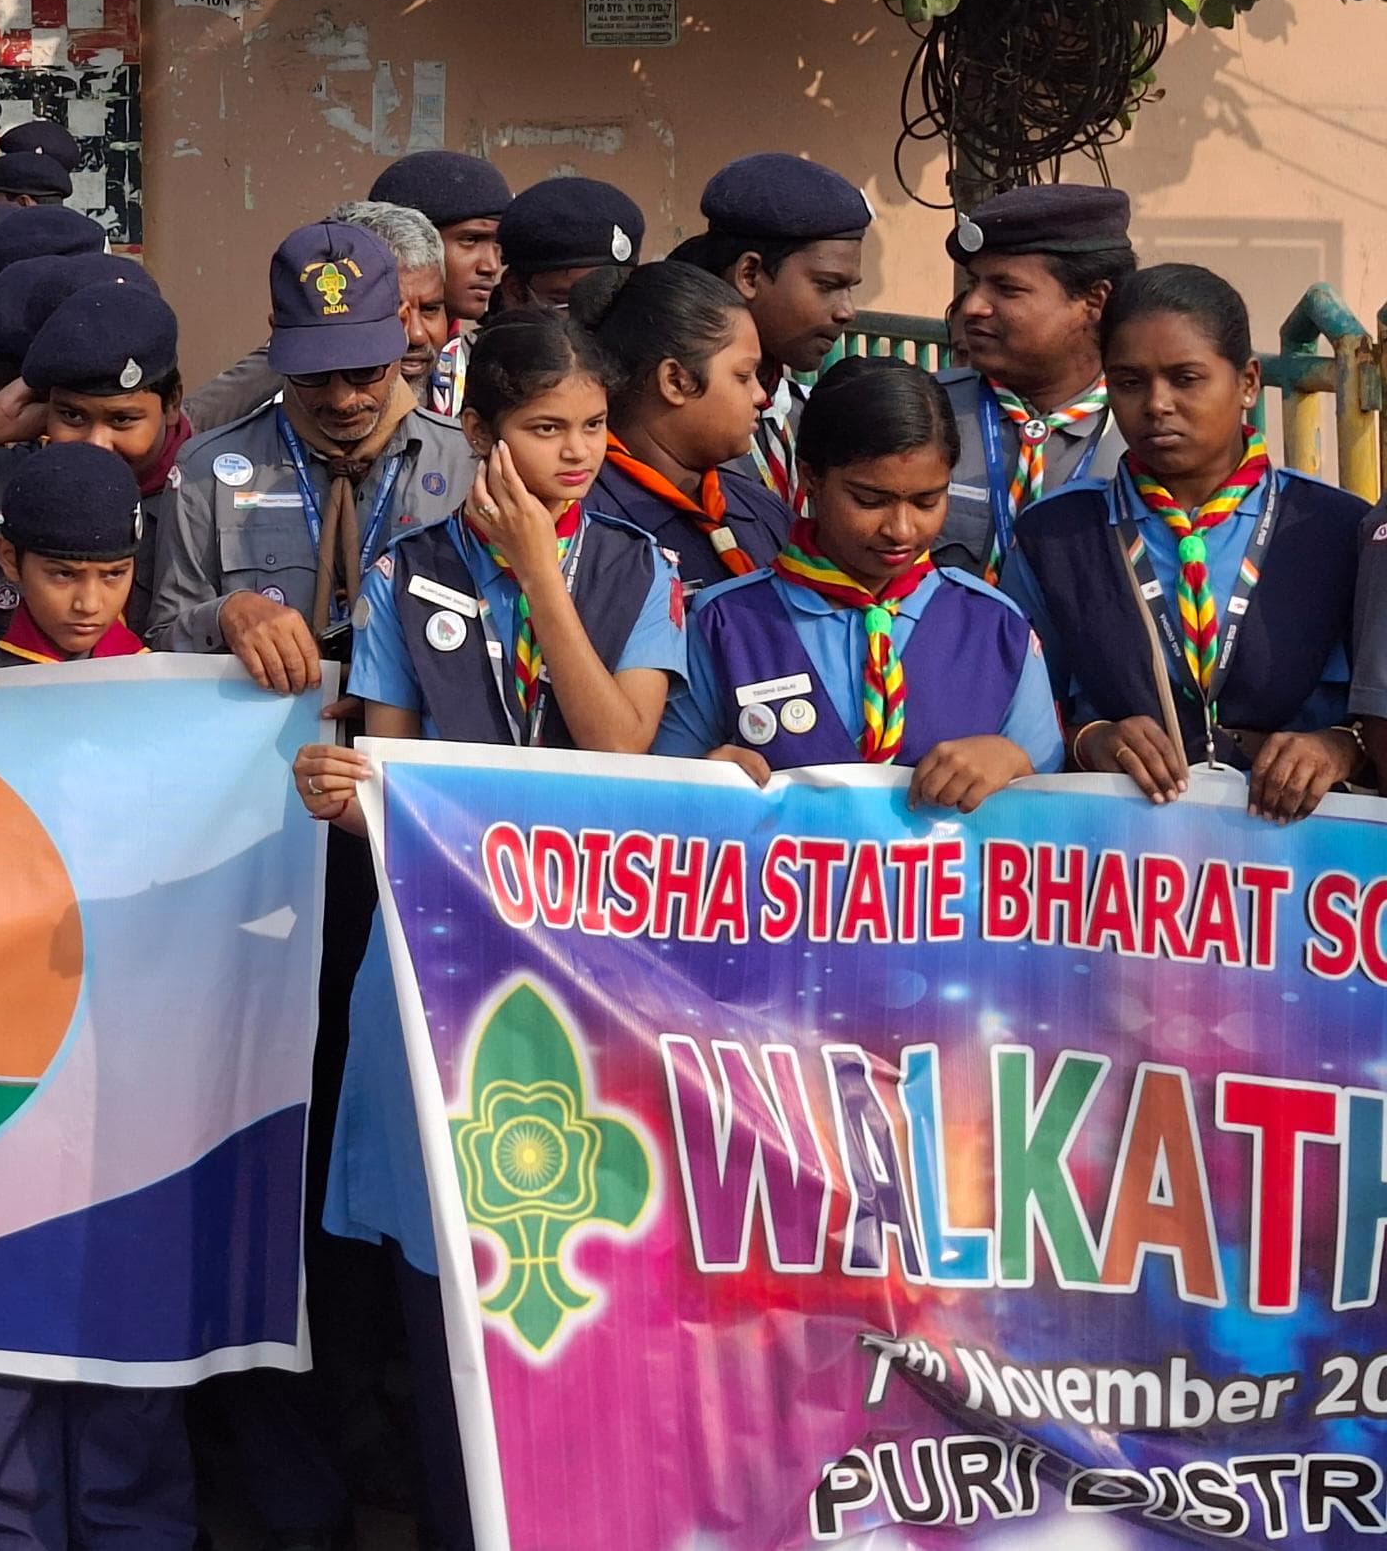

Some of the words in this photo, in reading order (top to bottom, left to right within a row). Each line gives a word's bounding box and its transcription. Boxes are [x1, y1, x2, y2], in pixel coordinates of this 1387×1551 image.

[588, 3, 605, 12] FOR
[323, 304, 350, 315] INDIA
[482, 822, 748, 943] ODISHA
[759, 837, 966, 944] STATE
[981, 840, 1294, 971] BHARAT
[858, 1332, 948, 1405] 7th
[954, 1345, 1296, 1431] November
[808, 1435, 1046, 1541] PURI
